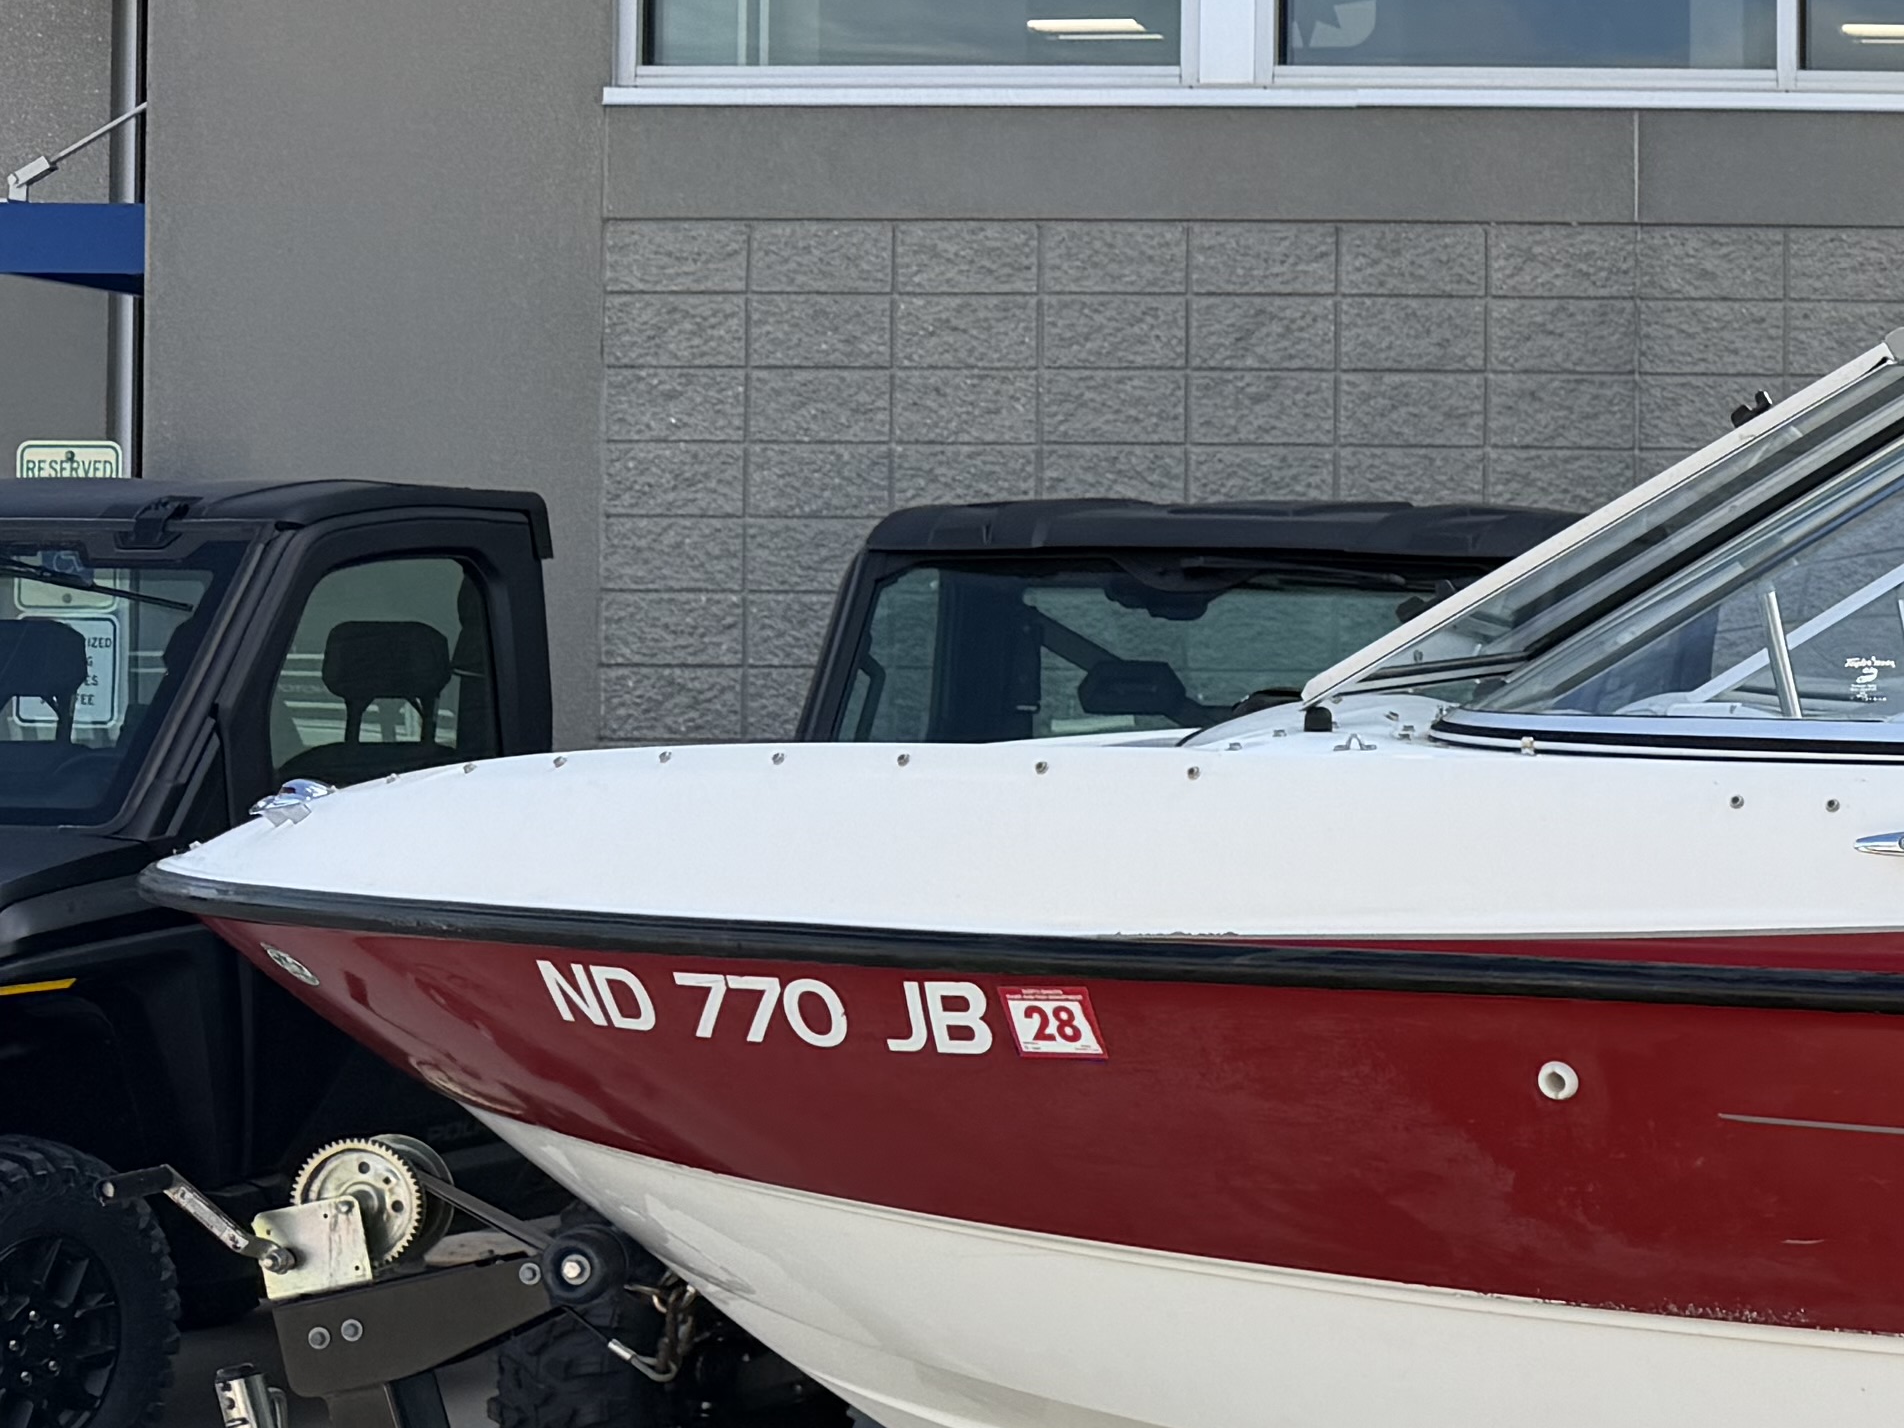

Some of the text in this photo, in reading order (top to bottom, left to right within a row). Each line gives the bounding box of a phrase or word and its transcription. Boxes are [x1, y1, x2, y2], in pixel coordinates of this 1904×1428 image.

[26, 459, 113, 477] RESERVED
[535, 959, 994, 1055] ND 770 JB
[1023, 1005, 1083, 1044] 28
